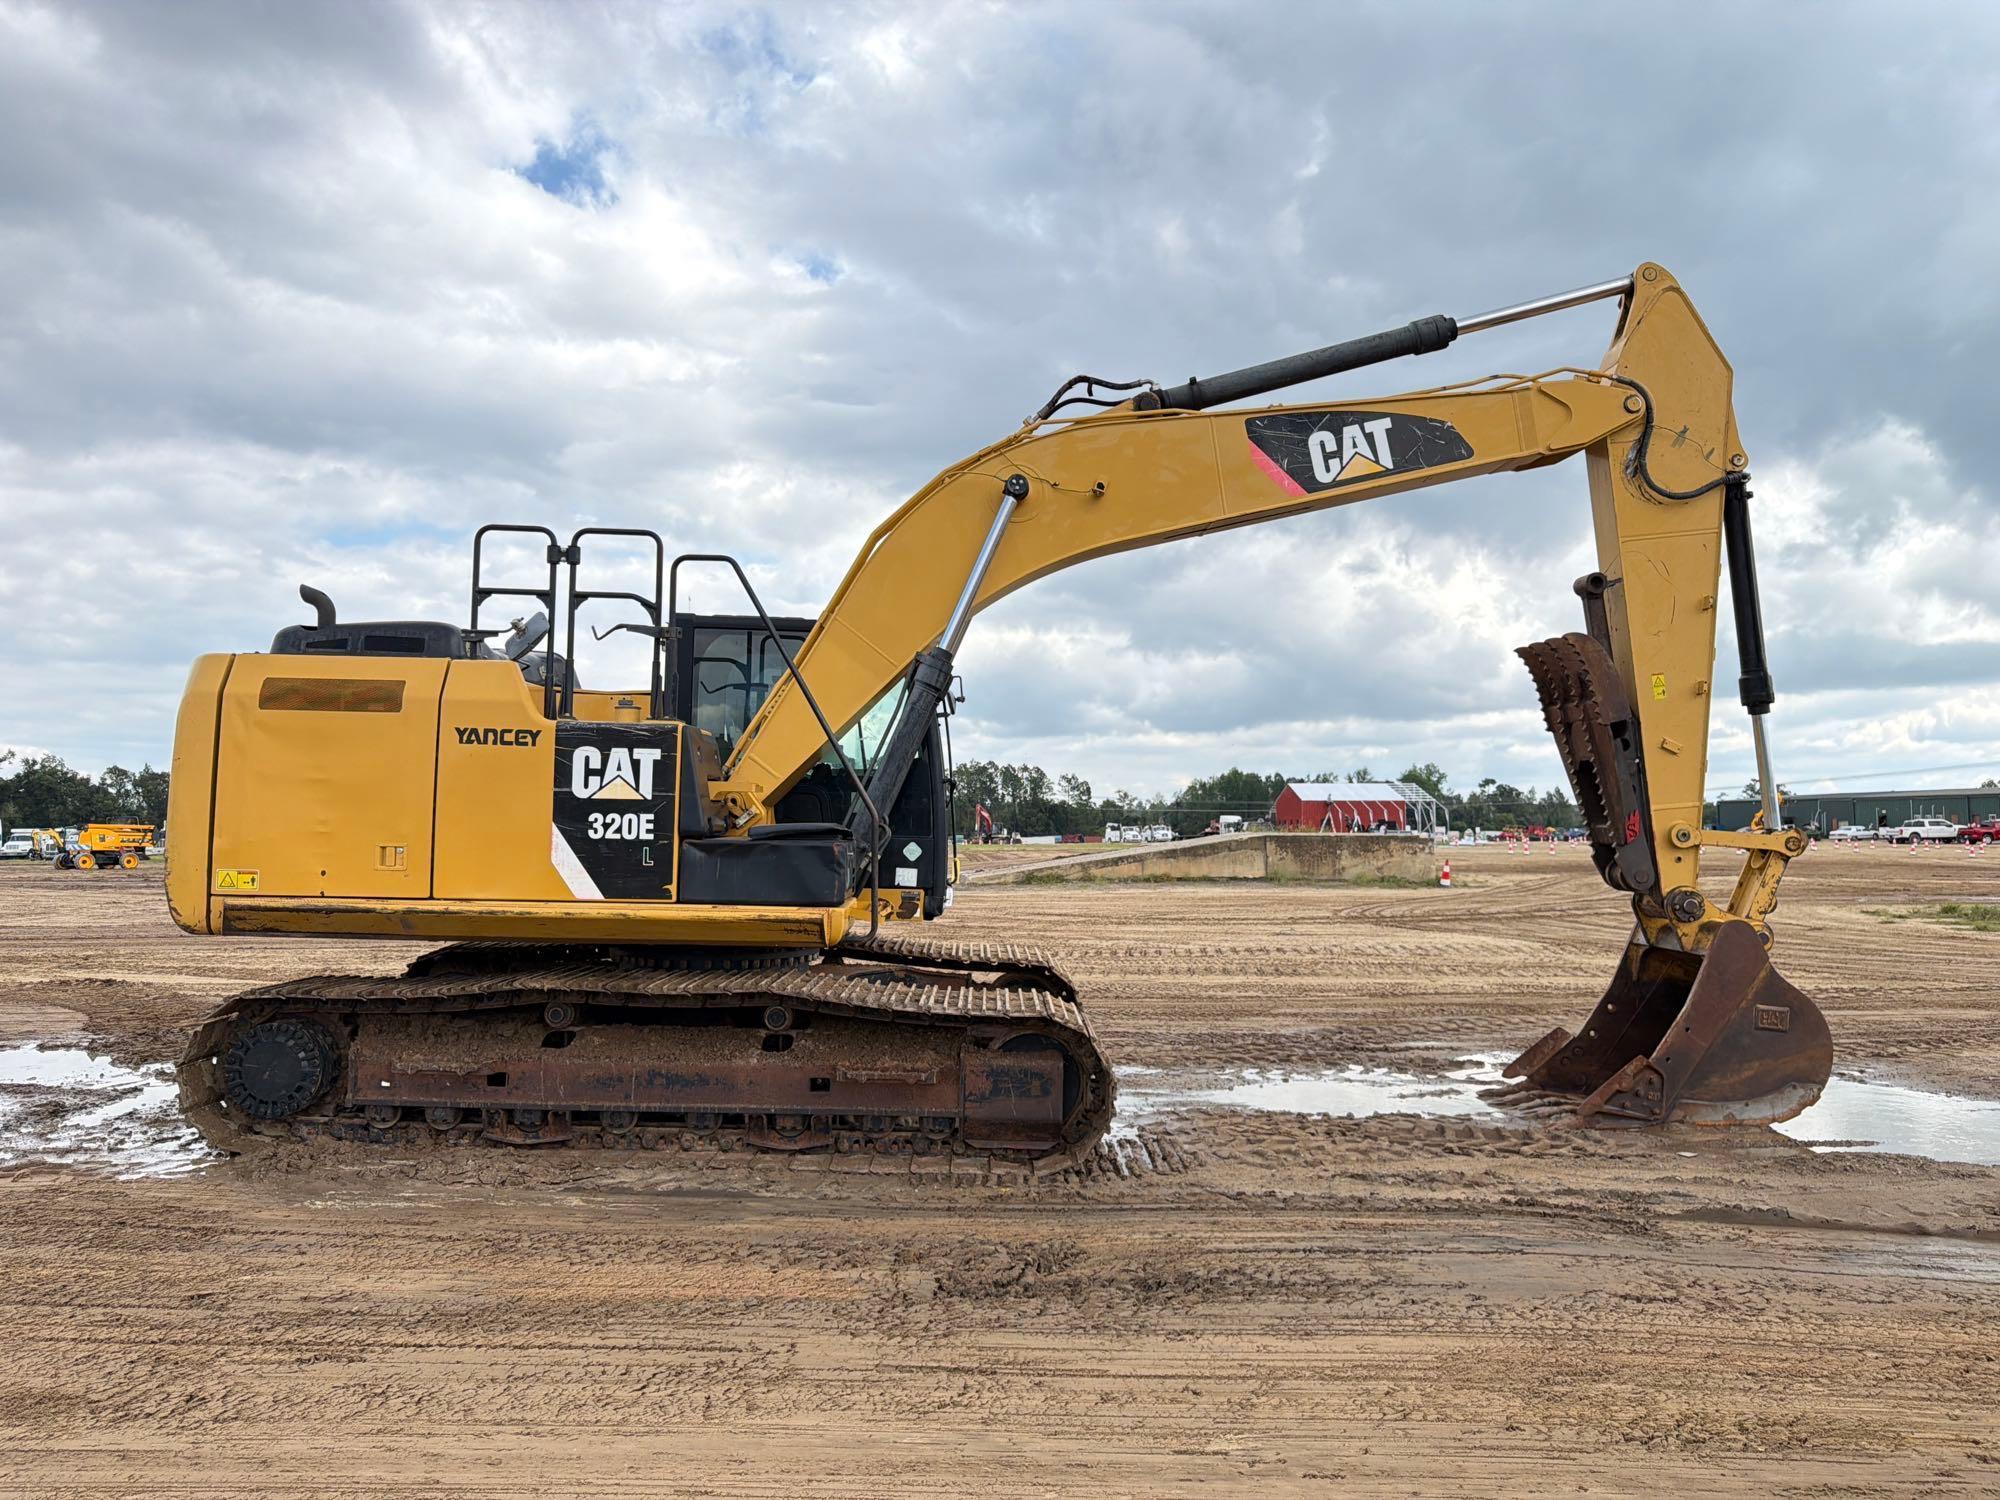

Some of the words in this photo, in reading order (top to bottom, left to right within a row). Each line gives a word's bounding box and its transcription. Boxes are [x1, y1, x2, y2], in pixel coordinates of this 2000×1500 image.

[1308, 417, 1393, 483] CAT
[454, 727, 542, 746] YANCEY
[571, 746, 661, 800] CAT
[588, 813, 654, 839] 320E
[642, 847, 654, 866] L
